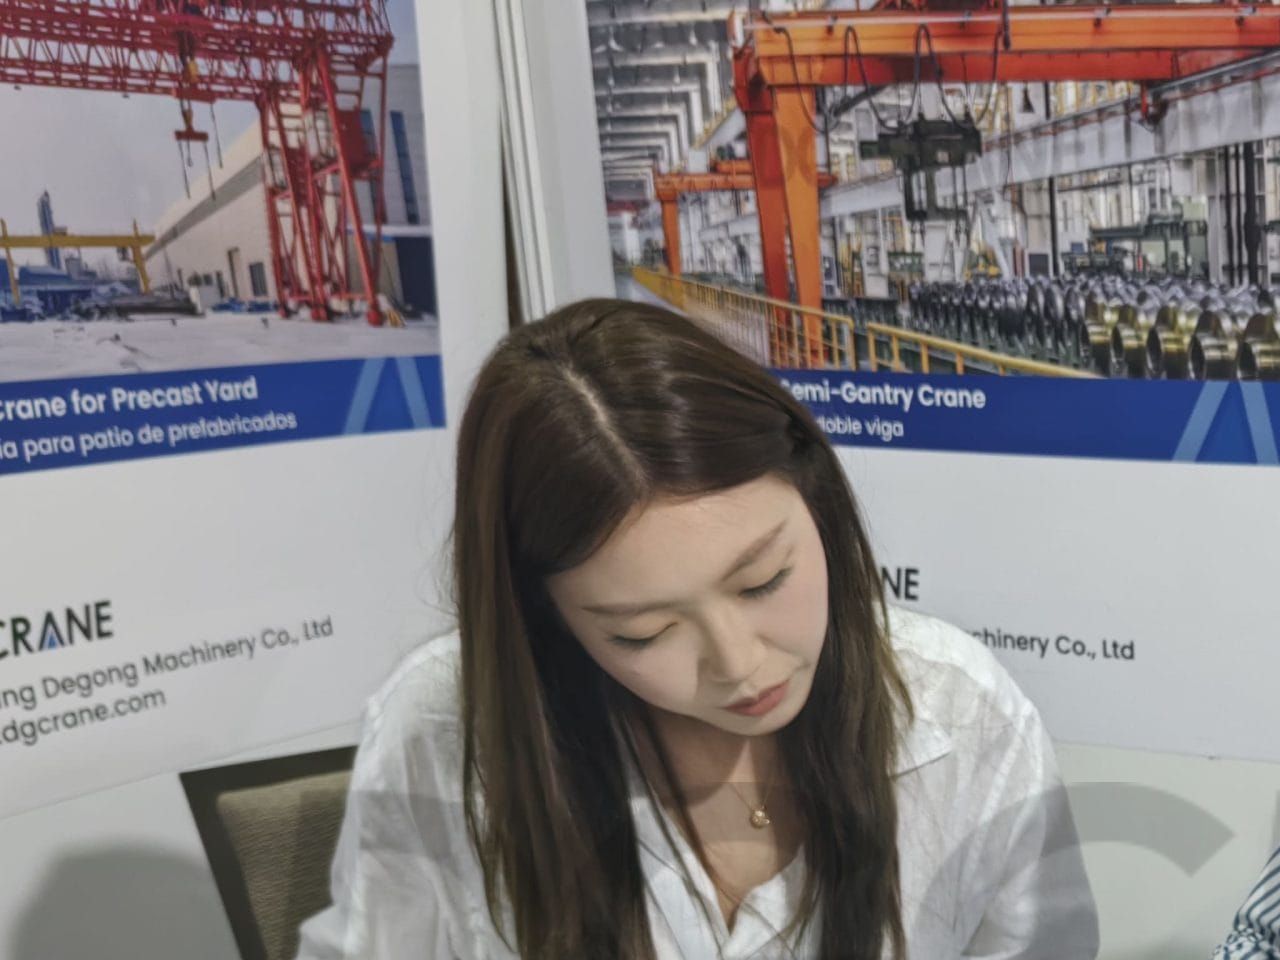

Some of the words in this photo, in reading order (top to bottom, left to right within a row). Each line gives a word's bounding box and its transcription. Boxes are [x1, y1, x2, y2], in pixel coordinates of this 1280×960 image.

[71, 386, 107, 415] for
[112, 381, 203, 411] Precast
[206, 375, 258, 401] Yard
[917, 385, 986, 410] Crane
[24, 435, 75, 462] para
[80, 424, 134, 455] patio
[138, 422, 164, 445] de
[168, 411, 298, 444] prefabricados
[866, 418, 904, 442] viga
[41, 659, 139, 696] Degong
[142, 633, 256, 675] Machinery
[261, 626, 300, 650] Co.,
[304, 615, 334, 639] Ltd
[1054, 635, 1097, 659] Co.,
[1102, 638, 1135, 661] Ltd
